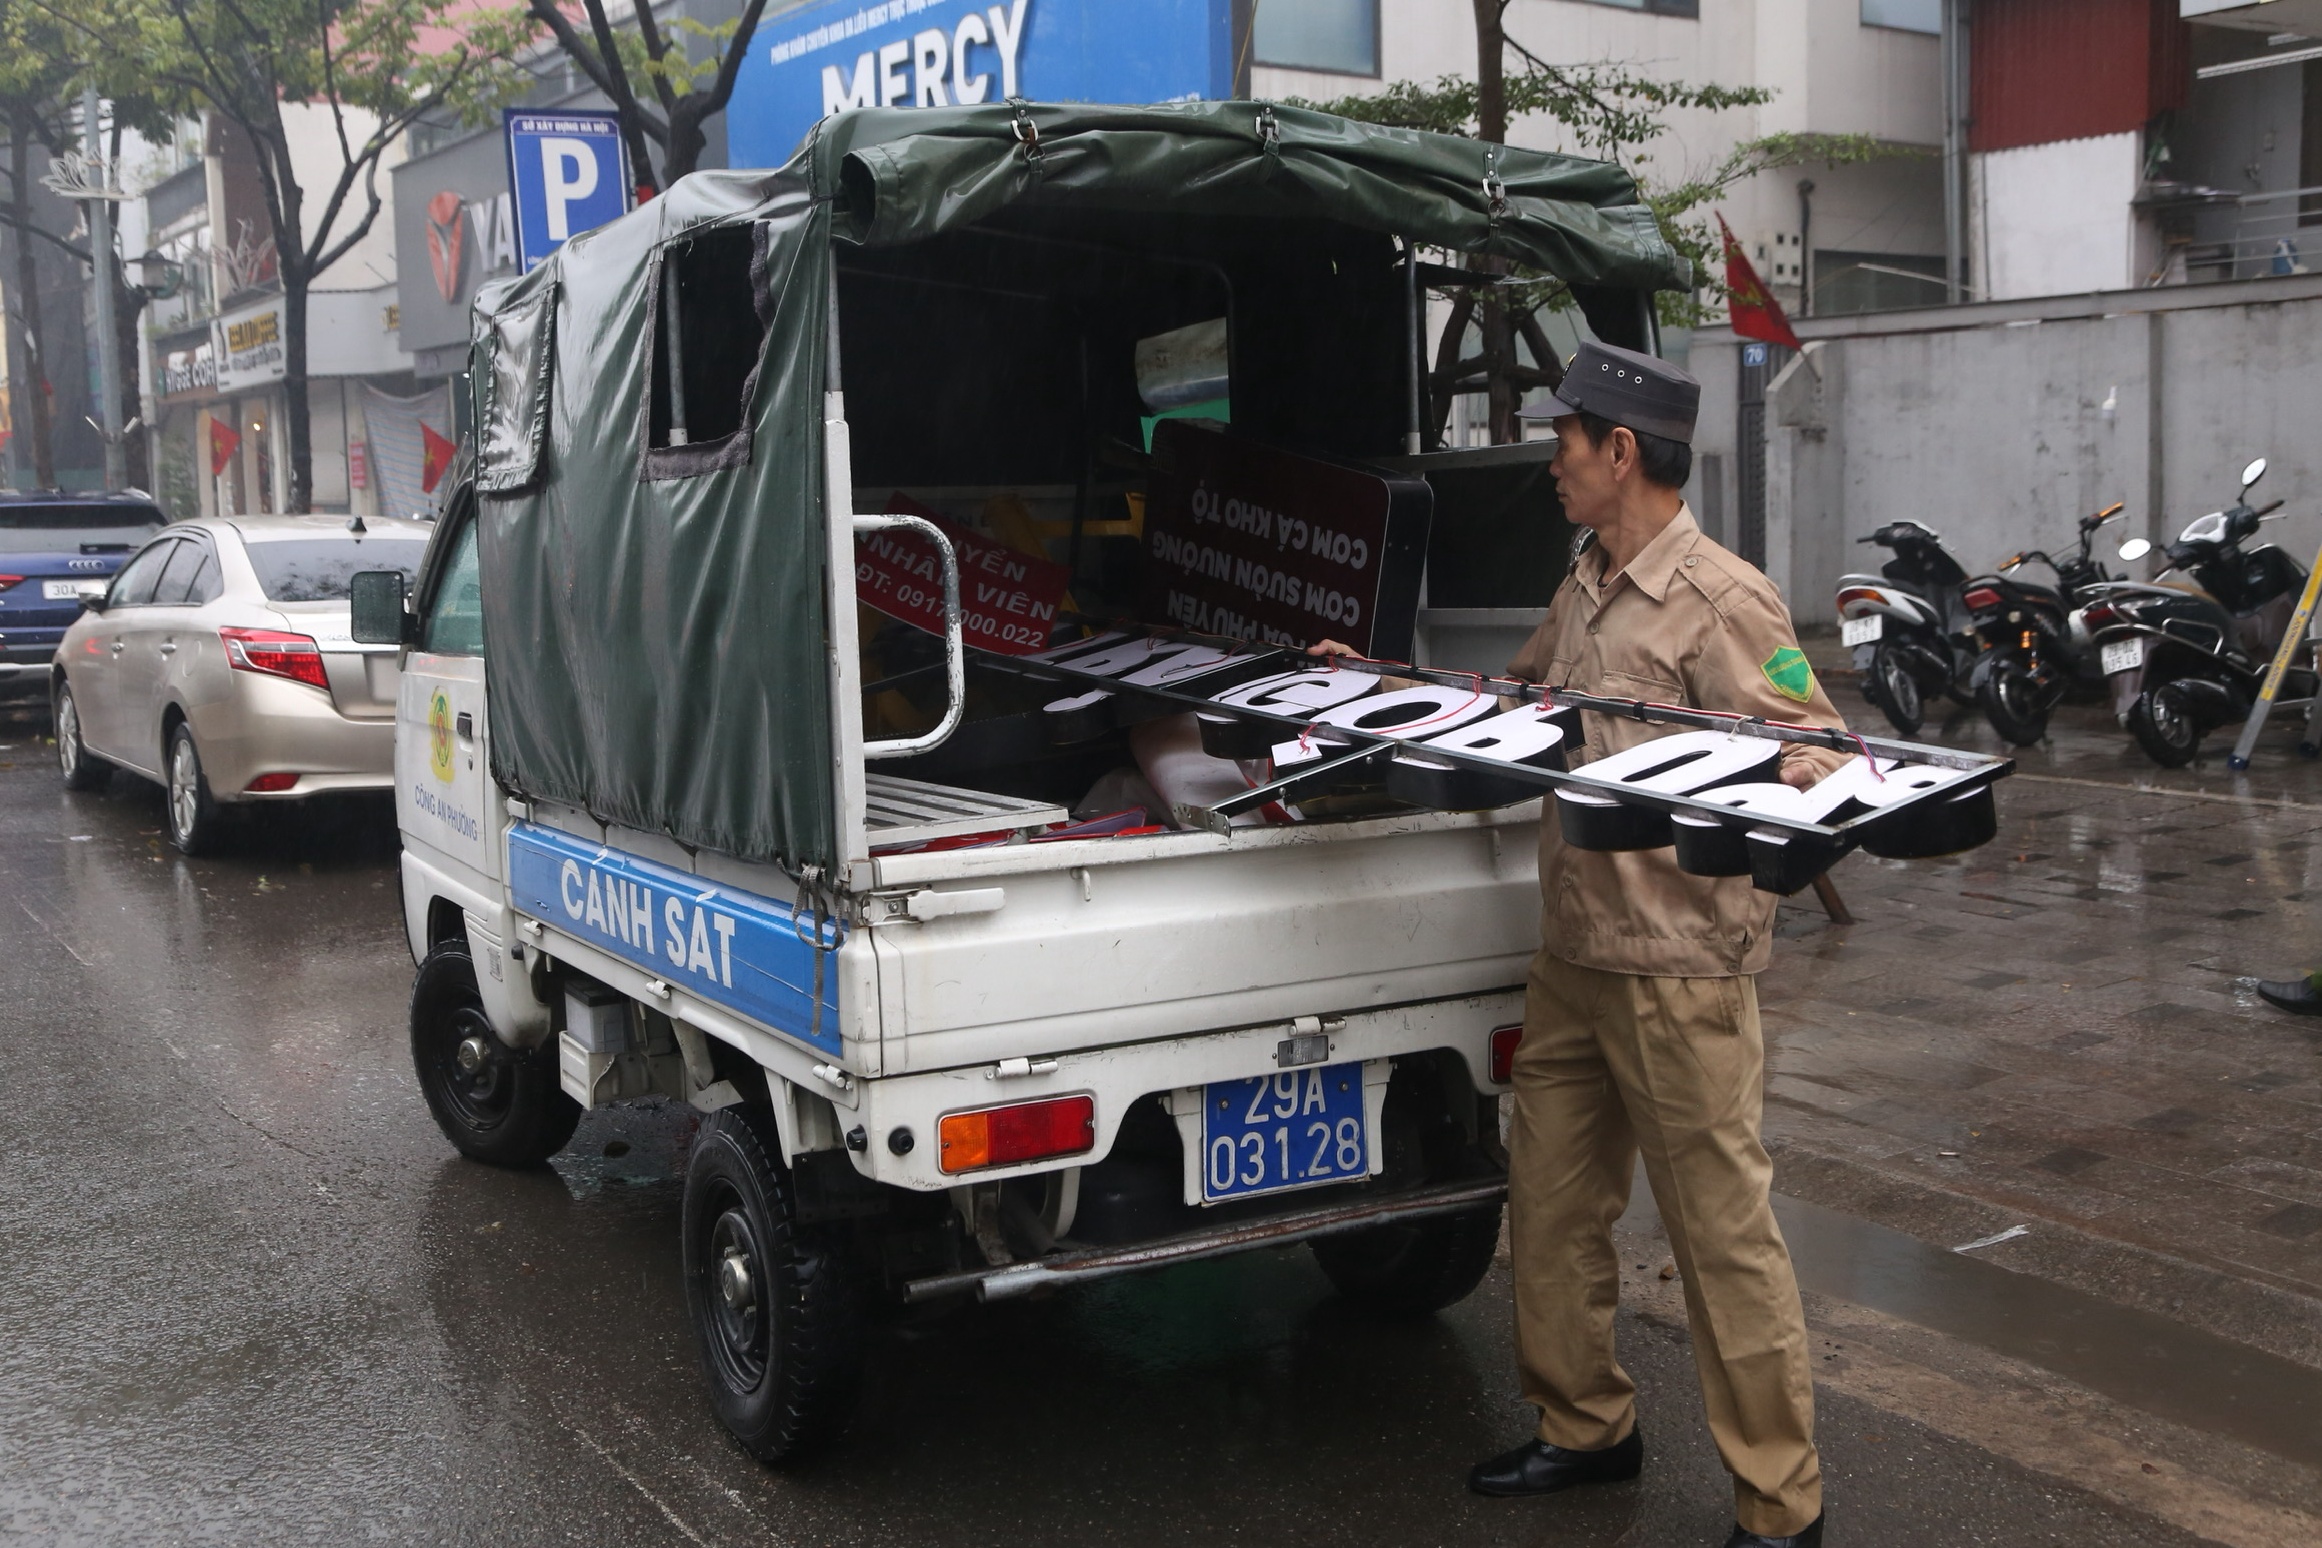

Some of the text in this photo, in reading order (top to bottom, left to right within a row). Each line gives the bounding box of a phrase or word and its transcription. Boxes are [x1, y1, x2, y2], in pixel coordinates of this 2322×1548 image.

[821, 0, 1028, 112] MERCY
[540, 137, 599, 241] P
[1747, 347, 1763, 363] 70
[1191, 479, 1368, 570] CƠM CÁ KHO TỘ
[897, 584, 1045, 648] 0917000.022
[978, 582, 1055, 622] VIÊN
[1152, 530, 1361, 628] CƠM SƯỜN NƯỚNG
[414, 783, 436, 815] CÔNG
[437, 799, 447, 823] AN
[664, 888, 736, 990] SÁT
[1245, 1068, 1327, 1125] 29A
[1211, 1117, 1361, 1191] 031.28
